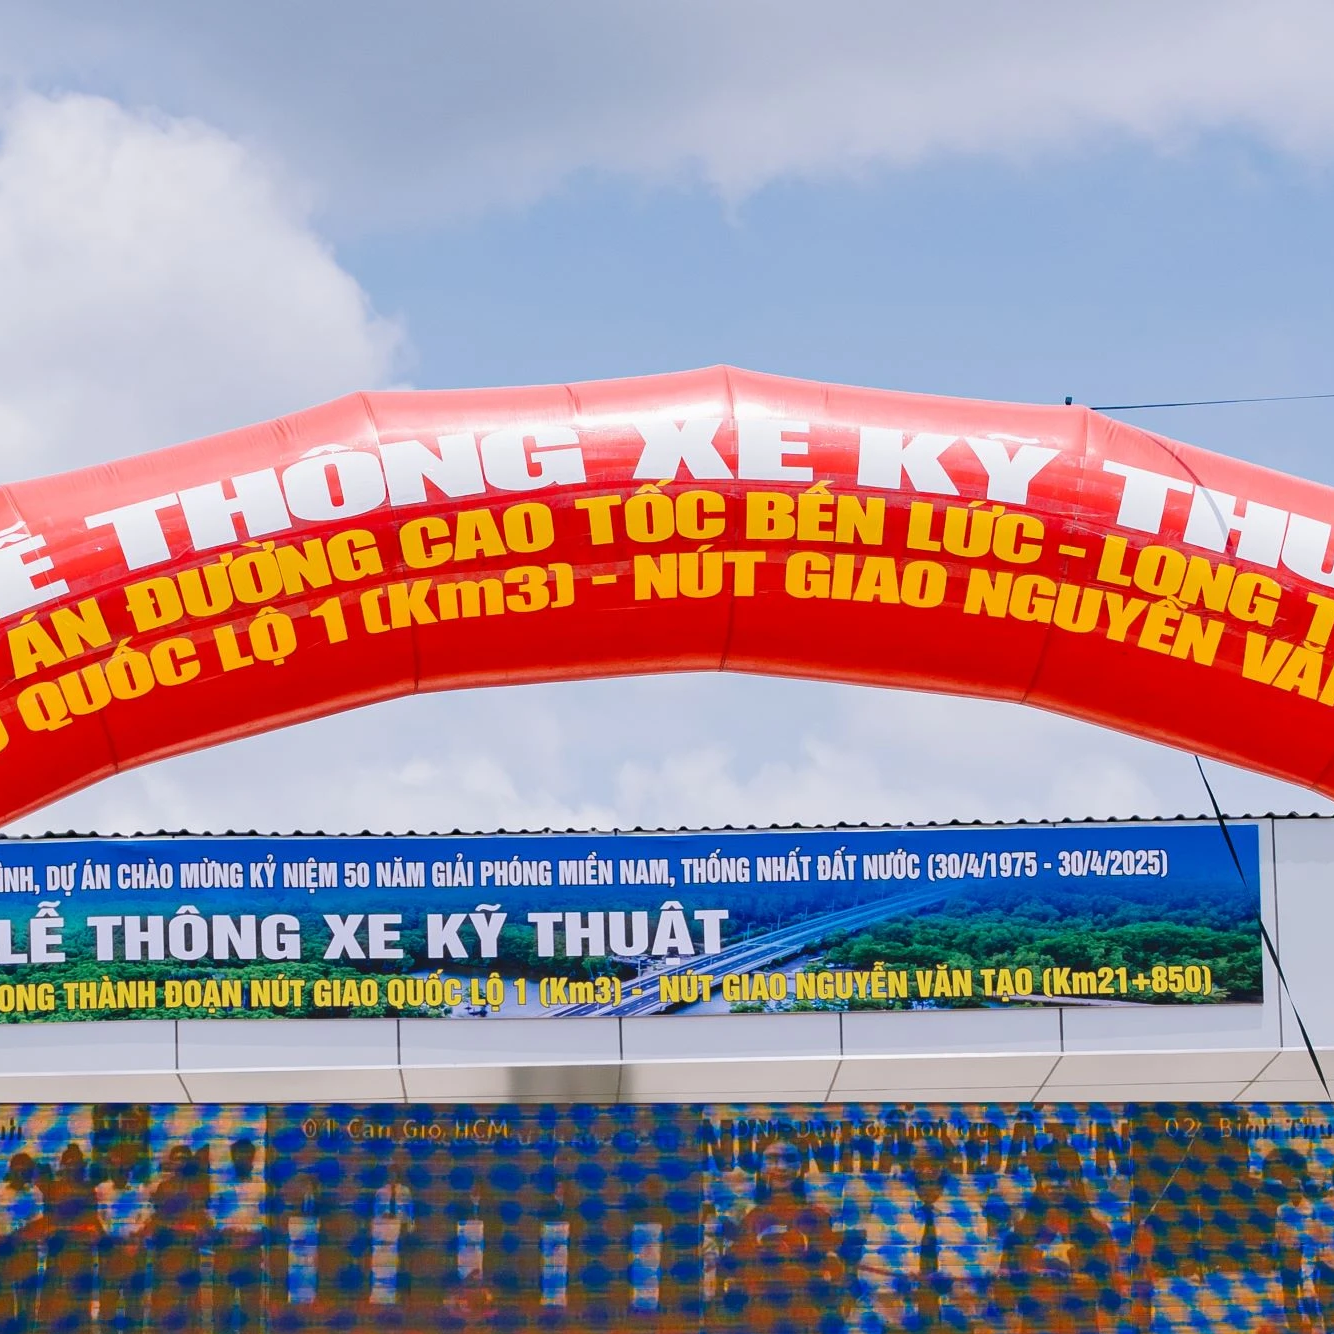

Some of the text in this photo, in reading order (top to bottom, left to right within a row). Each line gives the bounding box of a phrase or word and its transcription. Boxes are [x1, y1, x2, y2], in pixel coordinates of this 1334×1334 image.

[86, 424, 586, 571] THÔNG
[633, 415, 814, 484] XE
[858, 425, 1062, 507] KỸ
[7, 597, 112, 680] ÁN
[123, 529, 384, 633] ĐƯỜNG
[399, 502, 555, 569] CAO
[574, 479, 726, 545] TỐC
[746, 481, 886, 545] BẾN
[906, 499, 1045, 564] LỨC
[1096, 534, 1282, 627] LONG
[16, 635, 201, 731] QUỐC
[213, 604, 297, 674] LỘ
[309, 596, 348, 644] 1
[360, 562, 575, 634] (Km3)
[634, 545, 766, 601] NÚT
[785, 551, 948, 608] GIAO
[963, 568, 1225, 667] NGUYỄN
[47, 862, 77, 897] DỰ
[81, 859, 111, 891] ÁN
[117, 859, 174, 890] CHÀO
[180, 857, 244, 889] MỪNG
[250, 854, 275, 889] KỶ
[283, 857, 338, 894] NIỆM
[344, 861, 370, 888] 50
[376, 856, 425, 888] NĂM
[432, 853, 474, 888] GIẢI
[481, 855, 552, 887] PHÓNG
[559, 851, 614, 887] MIỀN
[619, 859, 676, 887] NAM,
[681, 848, 750, 884] THỐNG
[756, 847, 812, 882] NHẤT
[817, 846, 855, 881] ĐẤT
[863, 846, 920, 881] NƯỚC
[927, 851, 1037, 882] (30/4/1975
[1058, 849, 1168, 878] 30/4/2025)
[63, 976, 156, 1010] THÀNH
[164, 979, 243, 1014] ĐOẠN
[251, 973, 305, 1008] NÚT
[313, 978, 378, 1008] GIAO
[387, 968, 463, 1009] QUỐC
[471, 972, 504, 1013] LỘ
[513, 978, 527, 1005] 1
[539, 976, 623, 1007] (Km3)
[659, 969, 714, 1003] NÚT
[722, 973, 787, 1002] GIAO
[795, 960, 909, 1000] NGUYỄN
[916, 963, 972, 998] VĂN
[980, 968, 1033, 1002] TẠO
[87, 905, 301, 961] THÔNG
[323, 914, 404, 960] XE
[427, 903, 508, 959] KỸ
[527, 900, 730, 966] THUẬT
